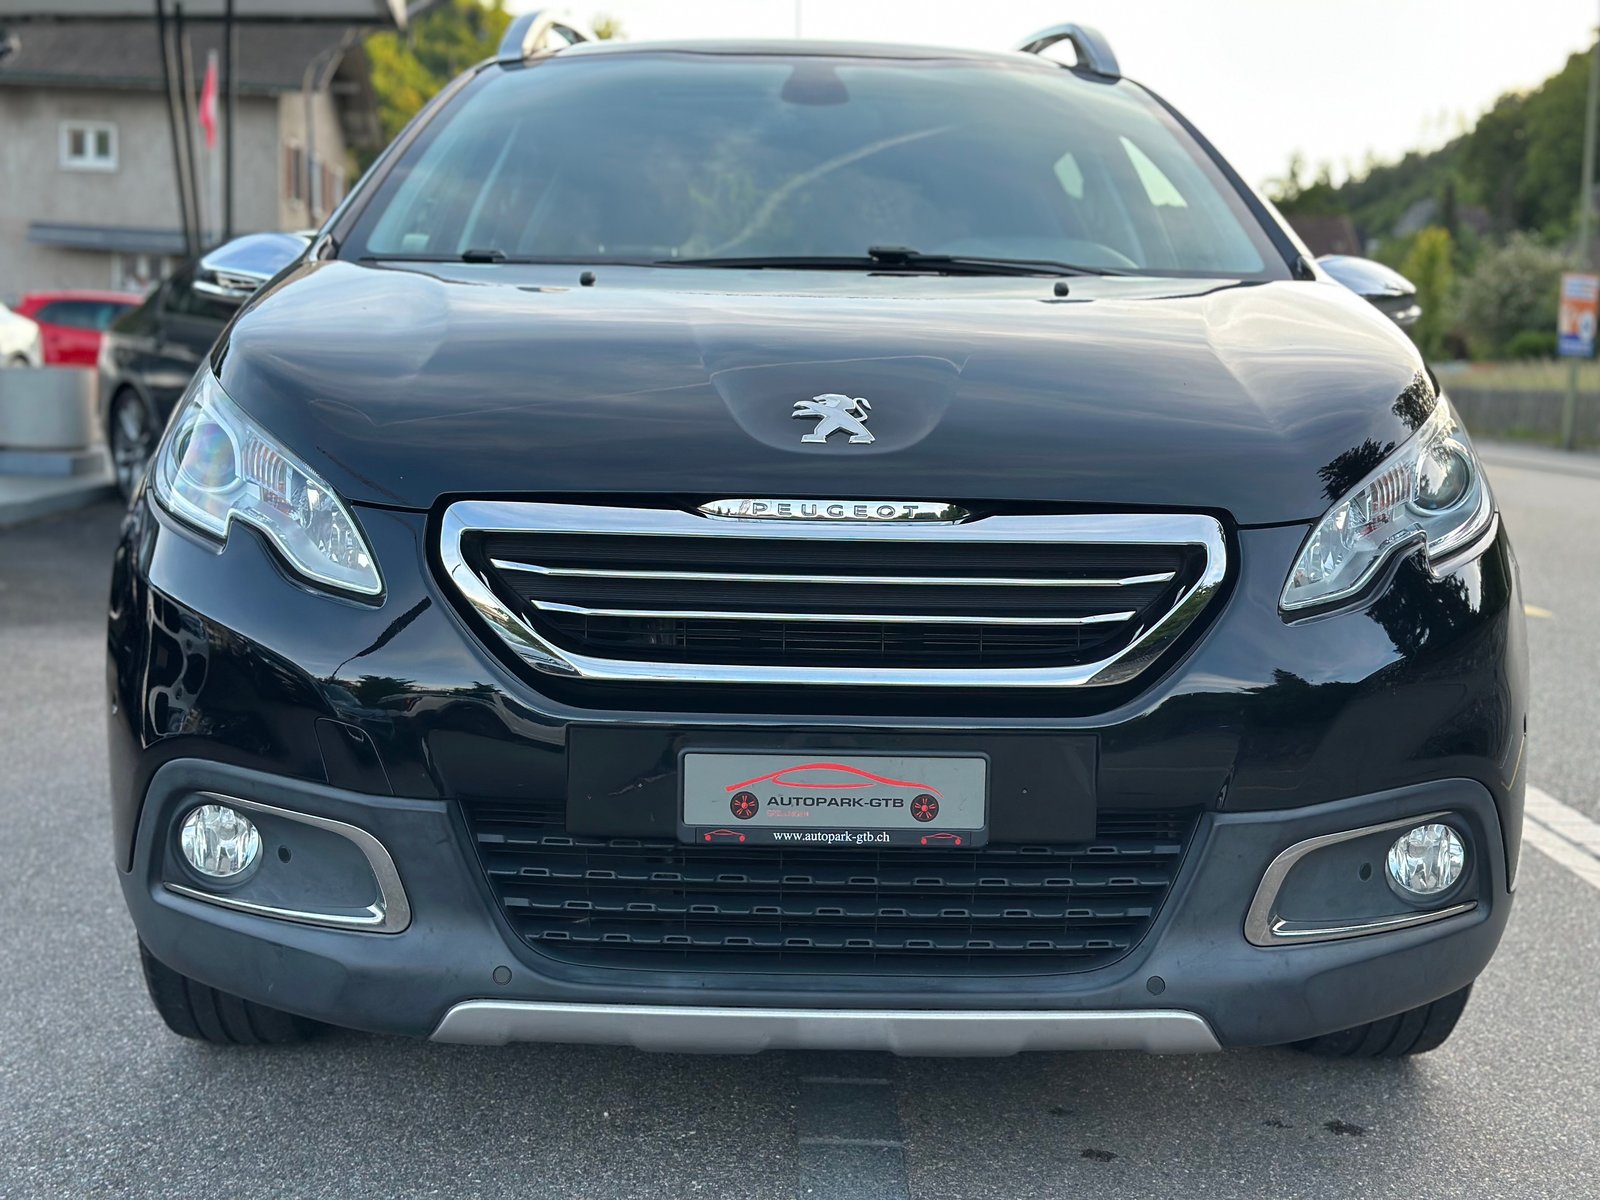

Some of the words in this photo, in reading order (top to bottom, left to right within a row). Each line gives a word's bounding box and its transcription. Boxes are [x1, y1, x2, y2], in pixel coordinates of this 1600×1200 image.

[752, 502, 919, 518] PEUGEOT
[767, 796, 905, 808] AUTOPARK-GTB
[773, 830, 890, 844] www.autopark-gtb.ch
